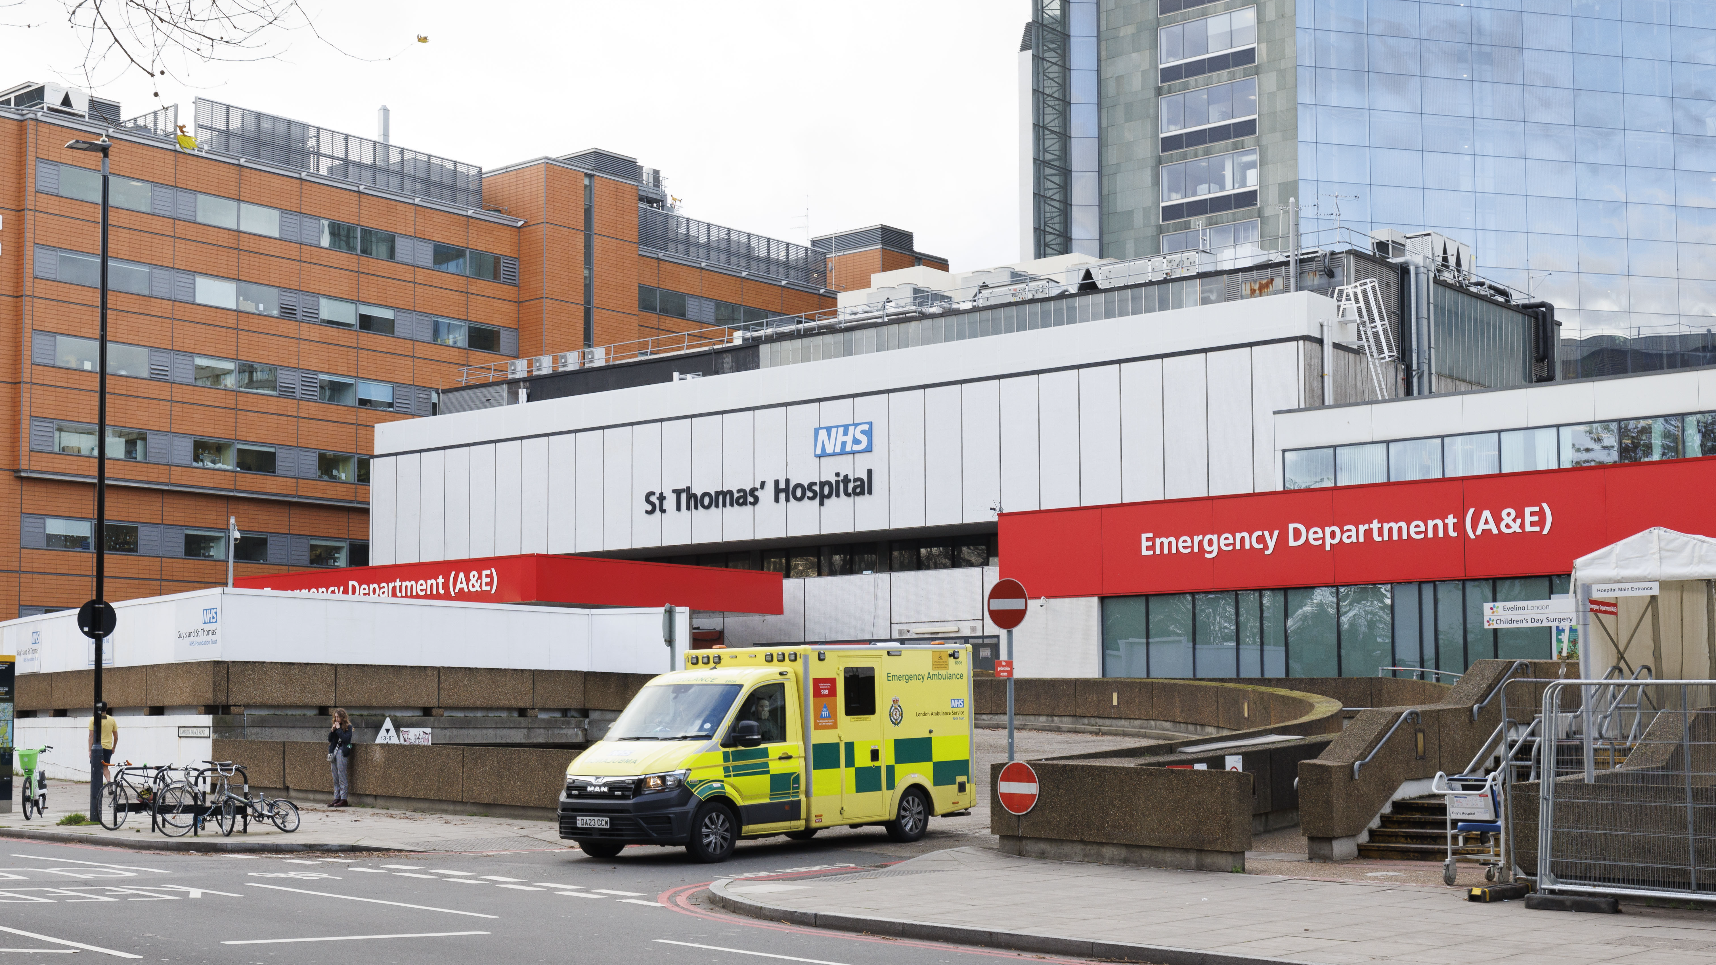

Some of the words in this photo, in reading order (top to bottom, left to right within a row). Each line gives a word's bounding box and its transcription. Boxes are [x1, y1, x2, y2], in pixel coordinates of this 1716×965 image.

[815, 423, 870, 455] NHS
[644, 490, 667, 515] St
[773, 468, 873, 507] Hospital
[1141, 526, 1279, 559] Emergency
[1288, 513, 1458, 551] Department
[1465, 503, 1552, 539] (A&E)
[349, 575, 445, 598] Department
[449, 568, 498, 596] (A&E)
[1502, 604, 1526, 612] Evelina
[203, 608, 217, 624] NHS
[1530, 617, 1544, 625] Day
[1545, 616, 1573, 625] Surgery
[886, 672, 925, 684] Emergency
[926, 671, 964, 681] Ambulance
[951, 699, 964, 707] NHS
[586, 785, 609, 793] MAN
